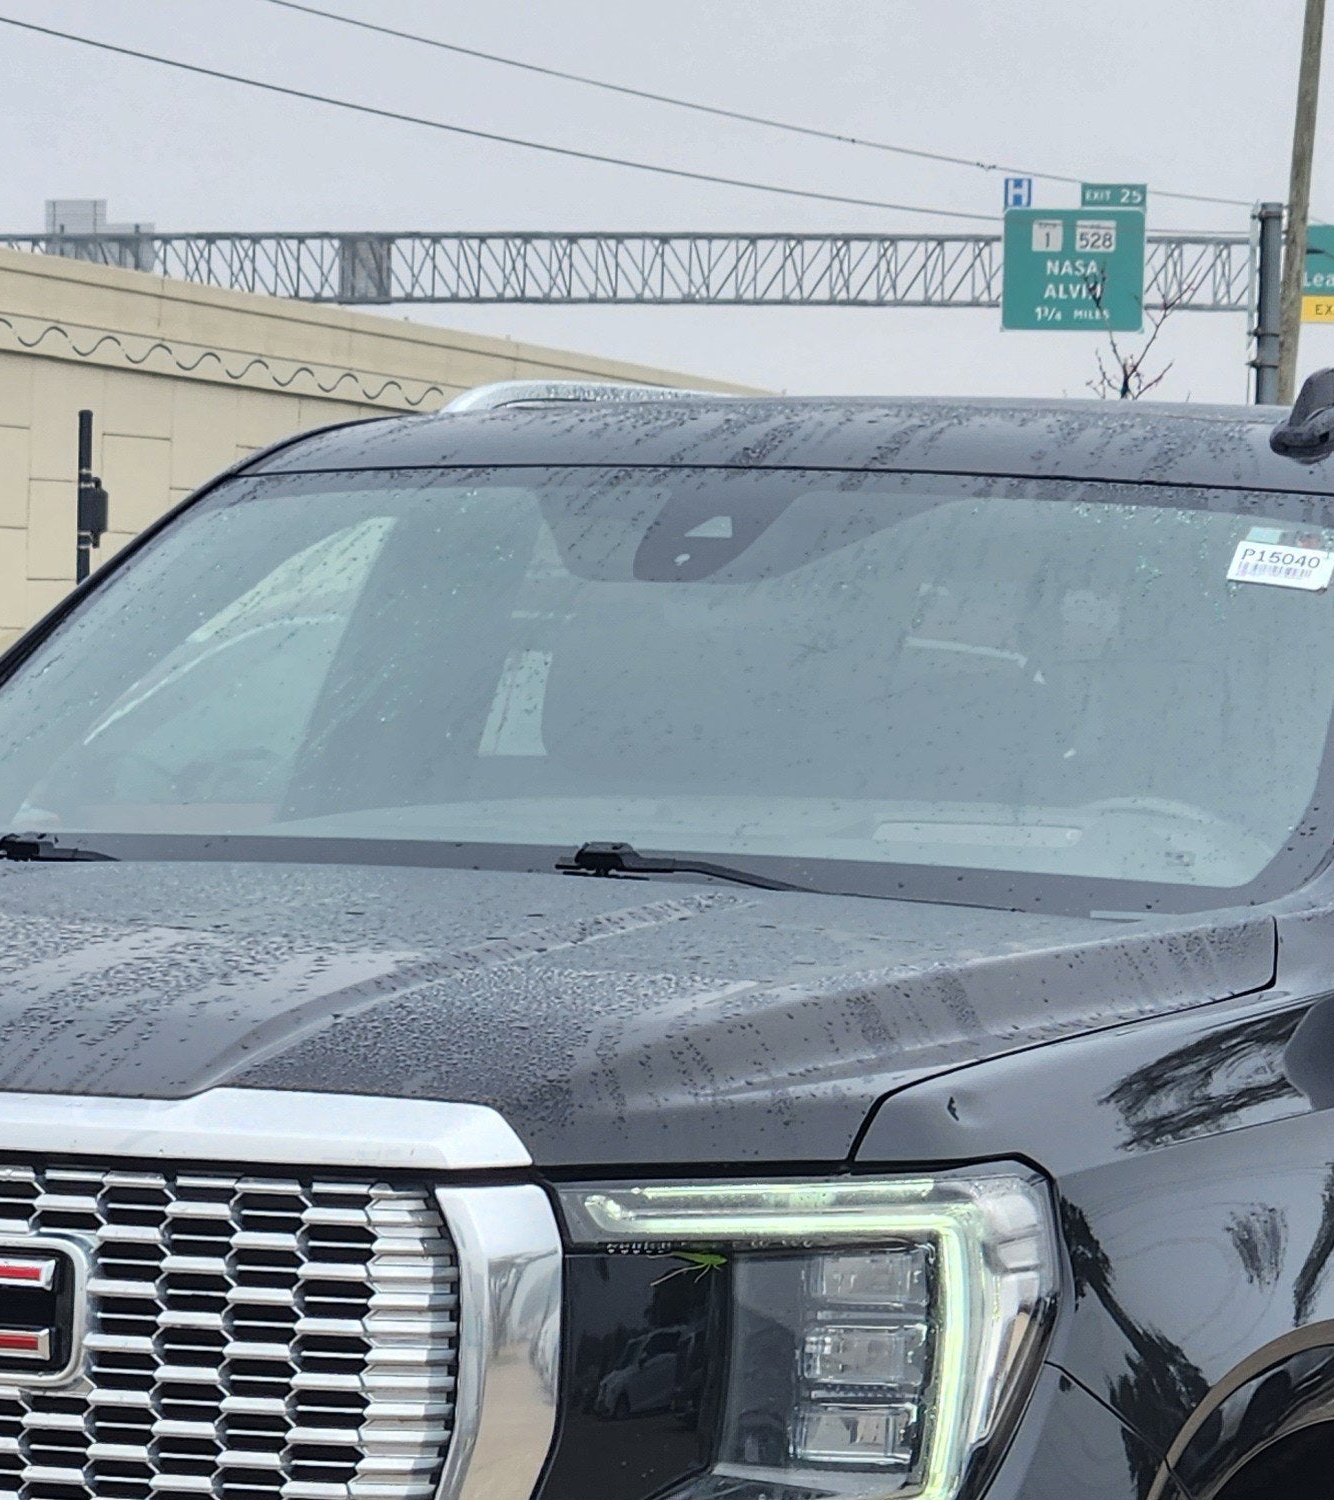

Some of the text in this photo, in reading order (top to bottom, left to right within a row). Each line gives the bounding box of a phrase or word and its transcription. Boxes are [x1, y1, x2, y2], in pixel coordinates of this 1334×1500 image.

[1007, 179, 1029, 206] H
[1085, 188, 1143, 203] EXIT 25
[1079, 231, 1113, 250] 528
[1046, 259, 1098, 276] NASA
[1073, 308, 1110, 321] MILES
[1241, 547, 1322, 569] P15040
